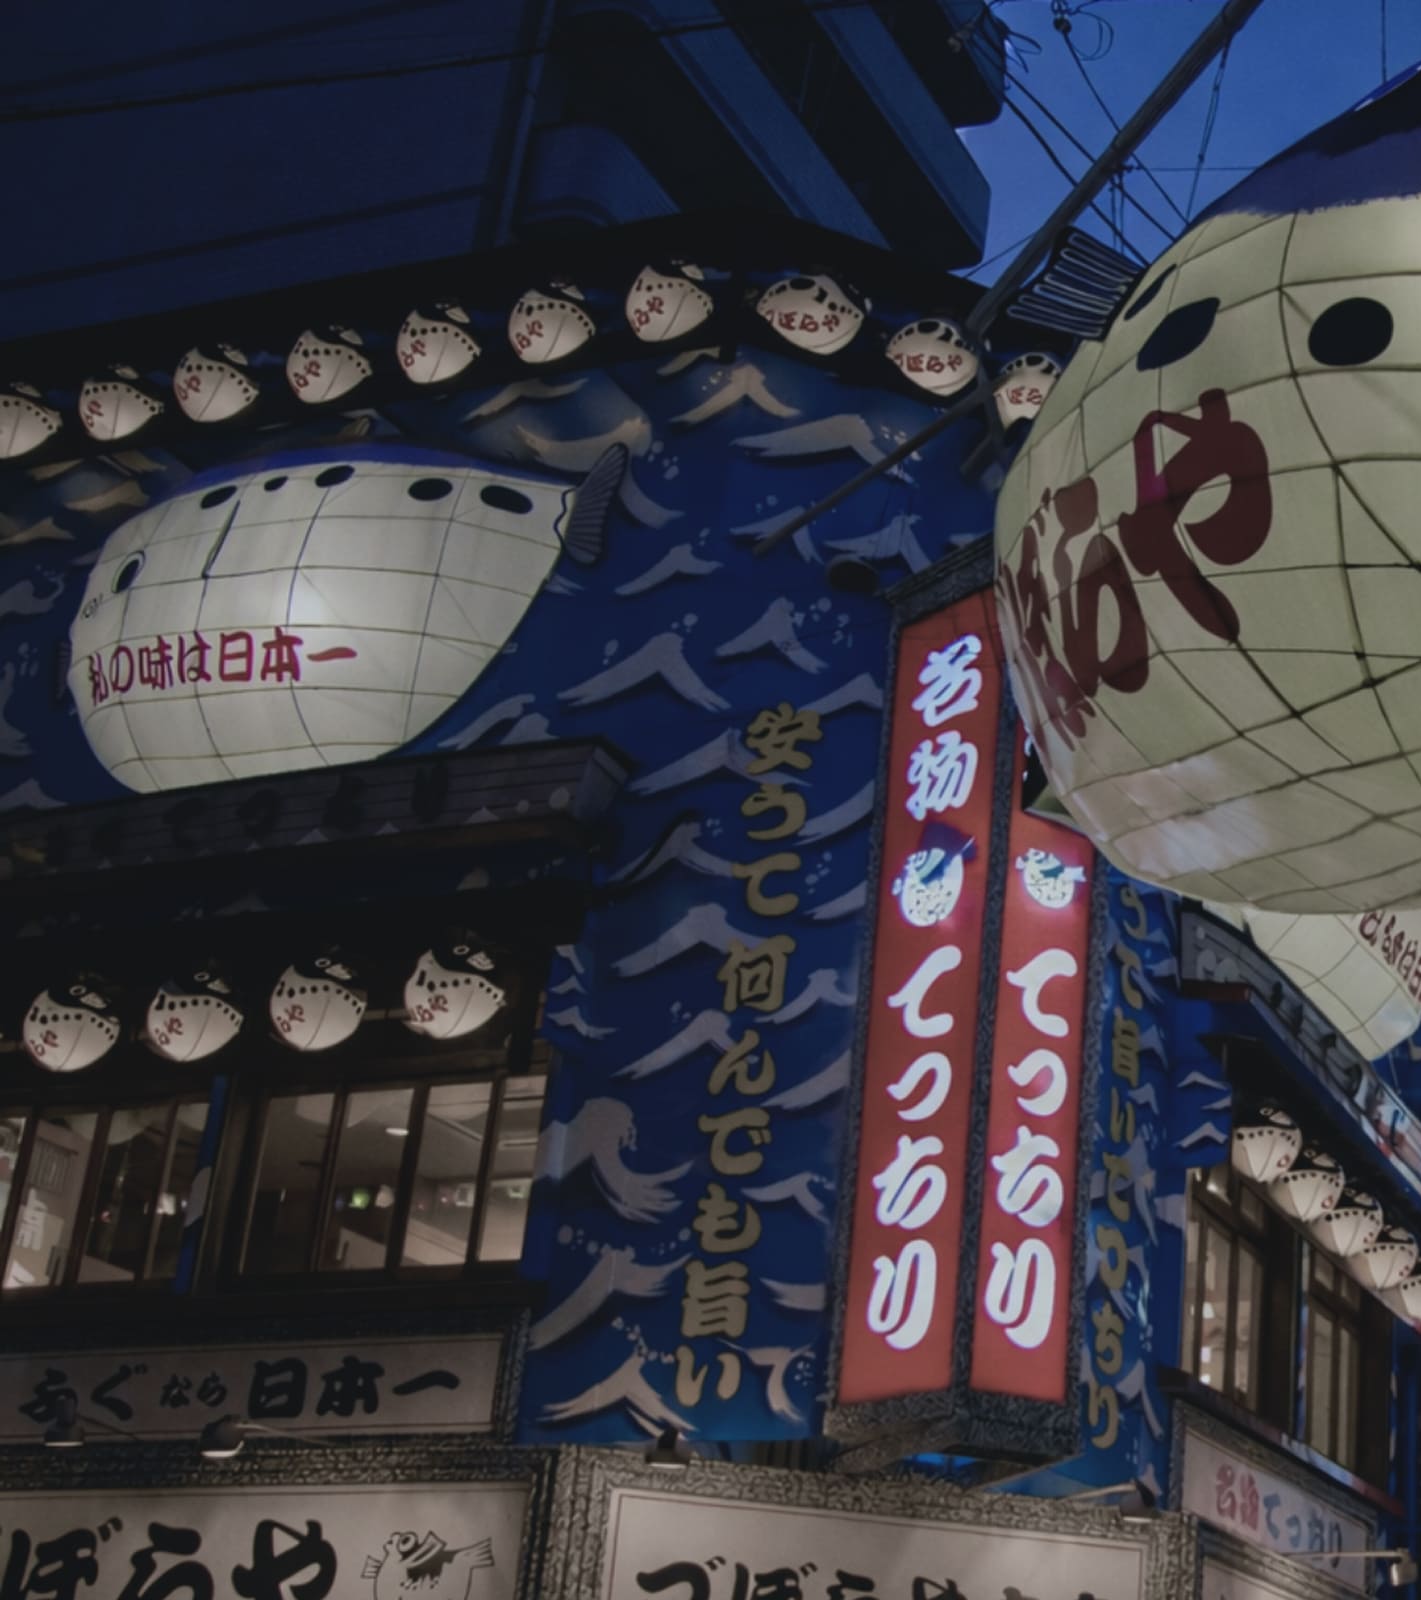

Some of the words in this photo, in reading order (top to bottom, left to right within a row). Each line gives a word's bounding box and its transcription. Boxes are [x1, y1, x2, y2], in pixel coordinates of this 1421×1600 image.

[904, 634, 984, 822] 名物
[674, 702, 824, 1407] 安うて何んでも旨い
[866, 945, 963, 1350] てっちり
[984, 947, 1079, 1350] てっちり
[20, 1356, 460, 1421] ふぐなら日本一
[0, 1517, 337, 1600] ぼらや
